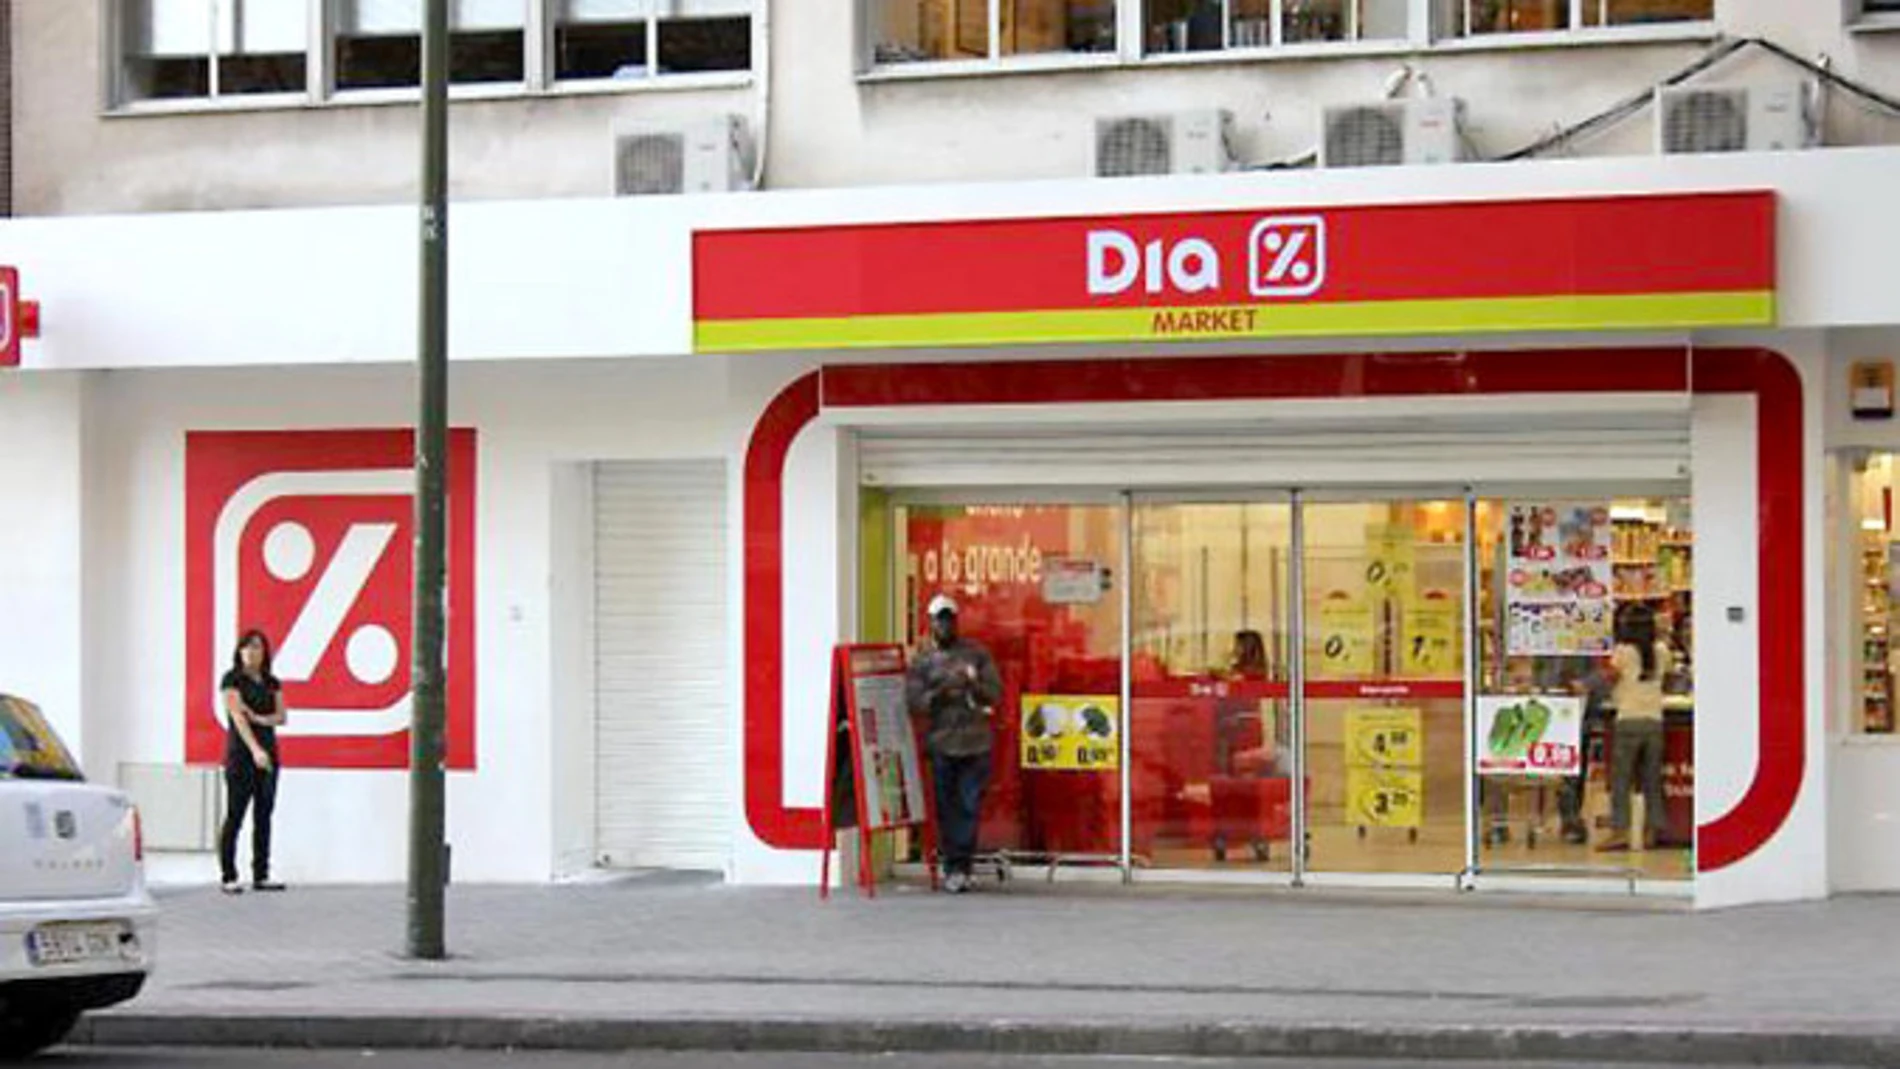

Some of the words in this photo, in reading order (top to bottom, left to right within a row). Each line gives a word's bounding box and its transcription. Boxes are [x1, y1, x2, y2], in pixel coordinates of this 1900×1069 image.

[1153, 309, 1258, 333] MARKET
[923, 550, 938, 582] a
[965, 531, 1041, 595] grande
